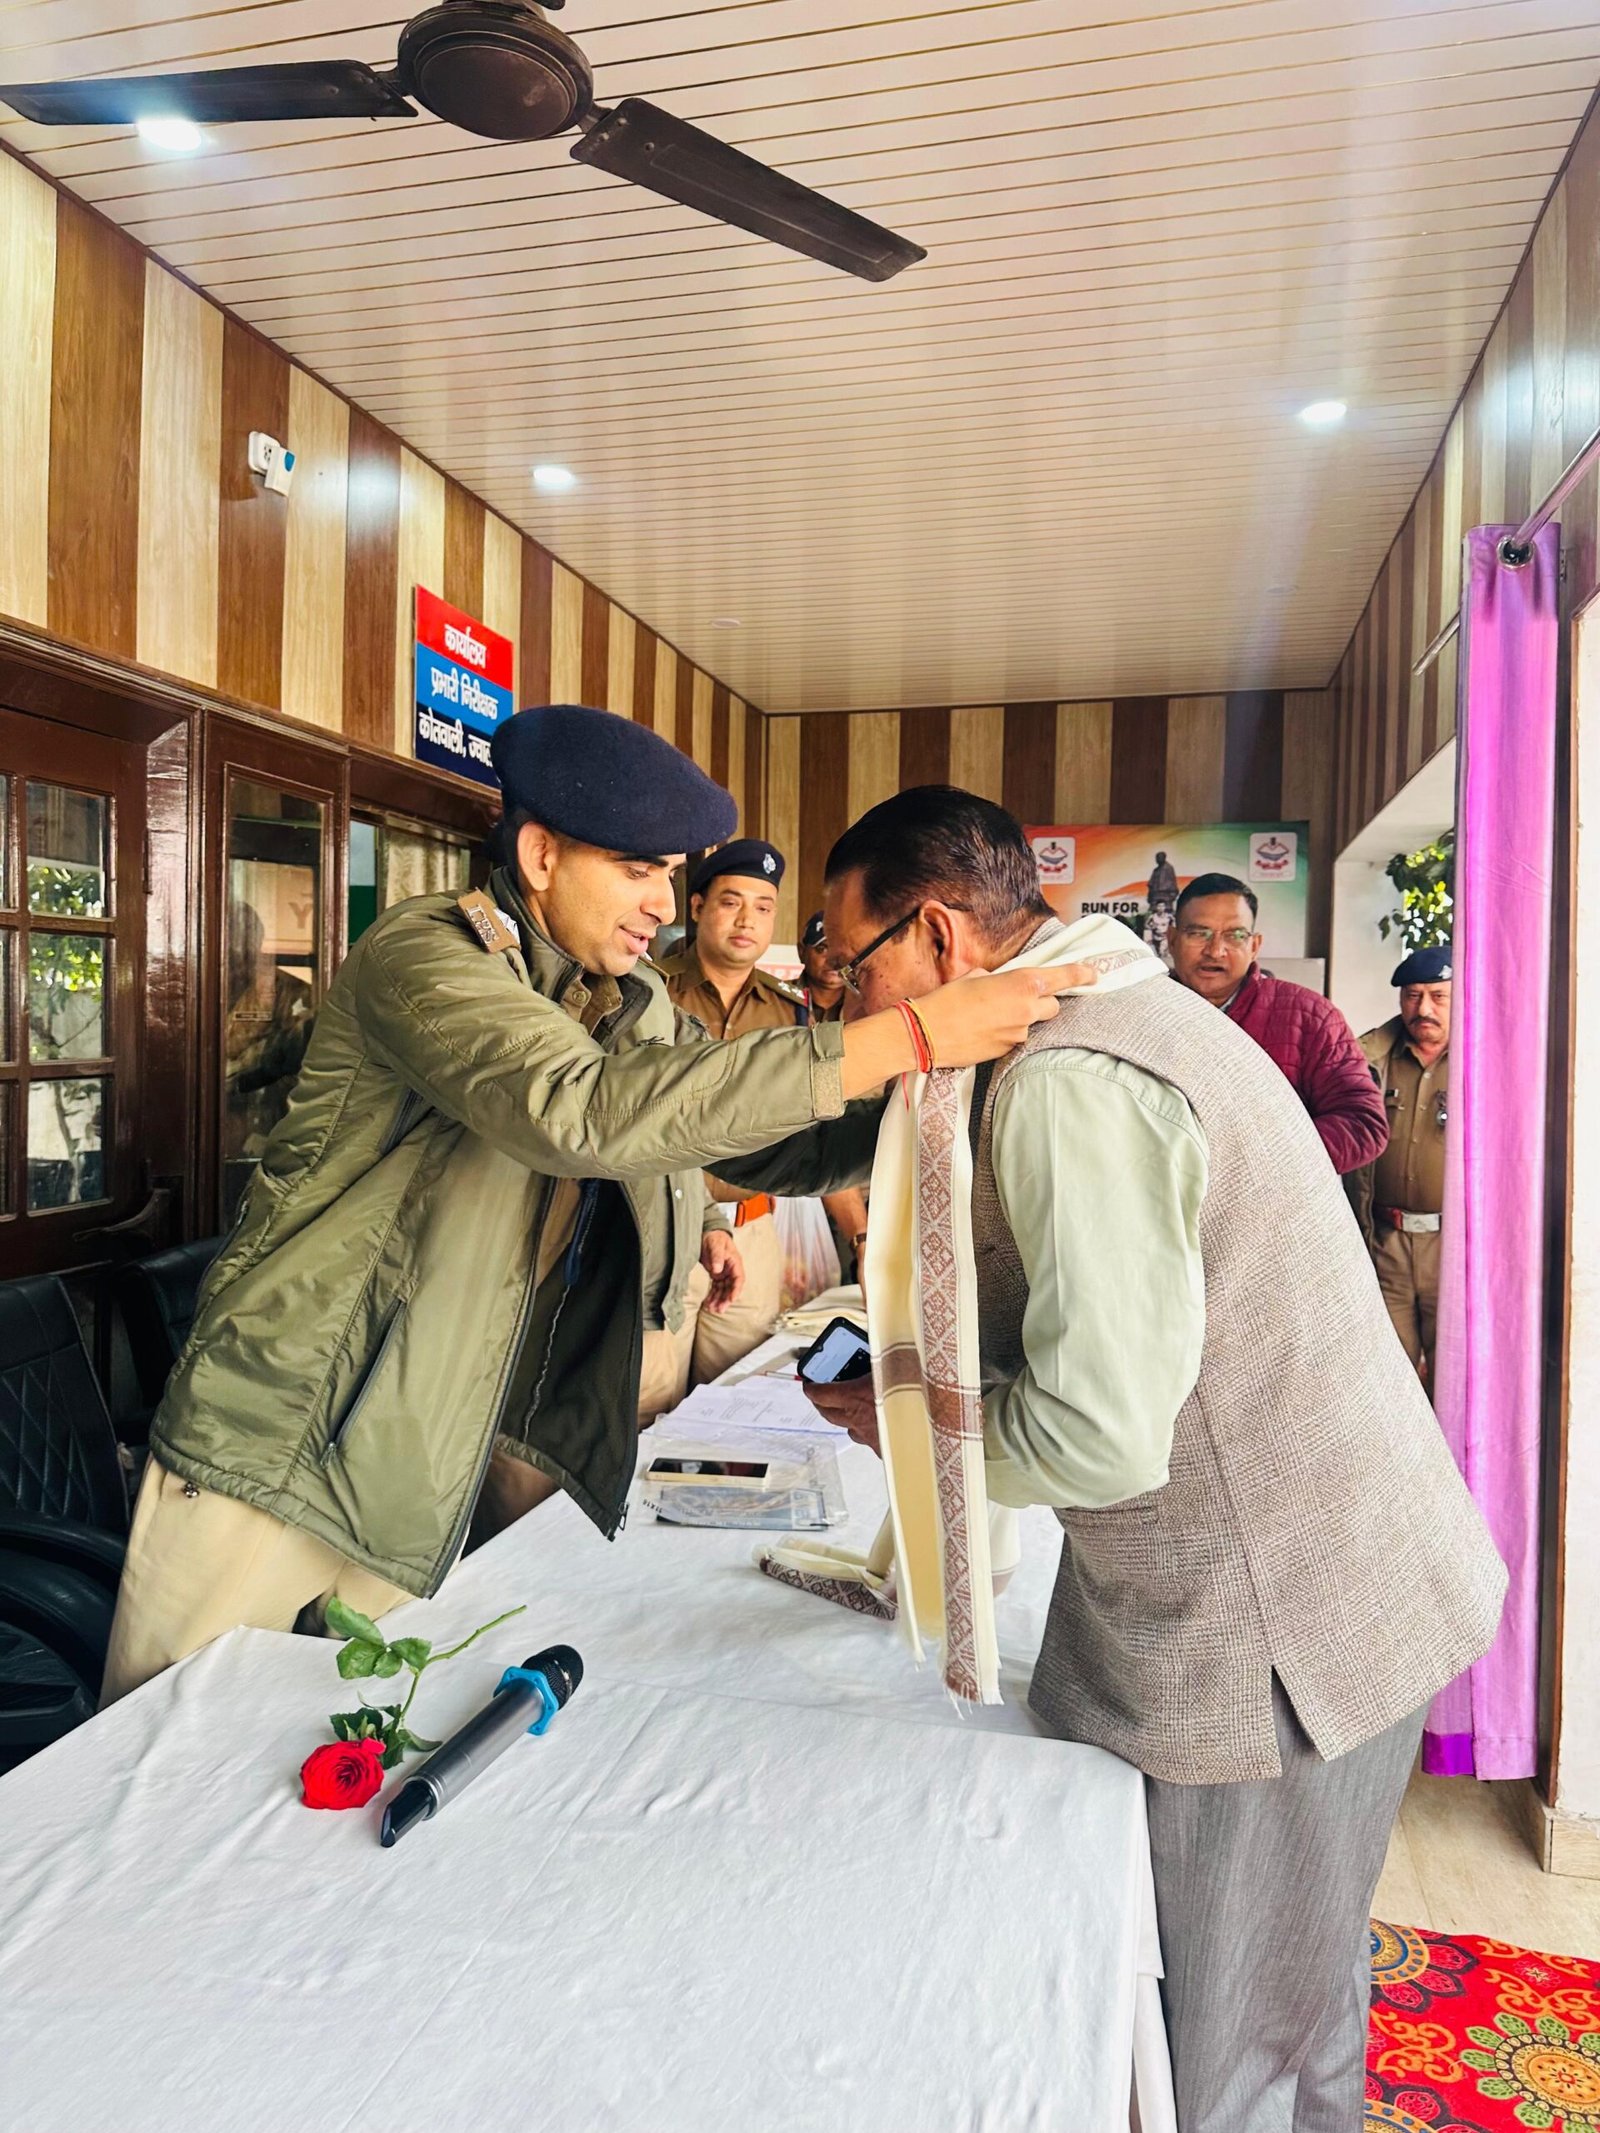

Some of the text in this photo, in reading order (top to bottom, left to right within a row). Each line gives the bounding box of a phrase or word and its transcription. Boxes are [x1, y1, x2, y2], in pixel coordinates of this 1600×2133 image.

[444, 623, 487, 669] कार्यालय
[431, 667, 499, 720] प्रभारी निरीक्षक
[418, 706, 467, 758] कोतवाली,
[1081, 902, 1139, 914] RUN FOR
